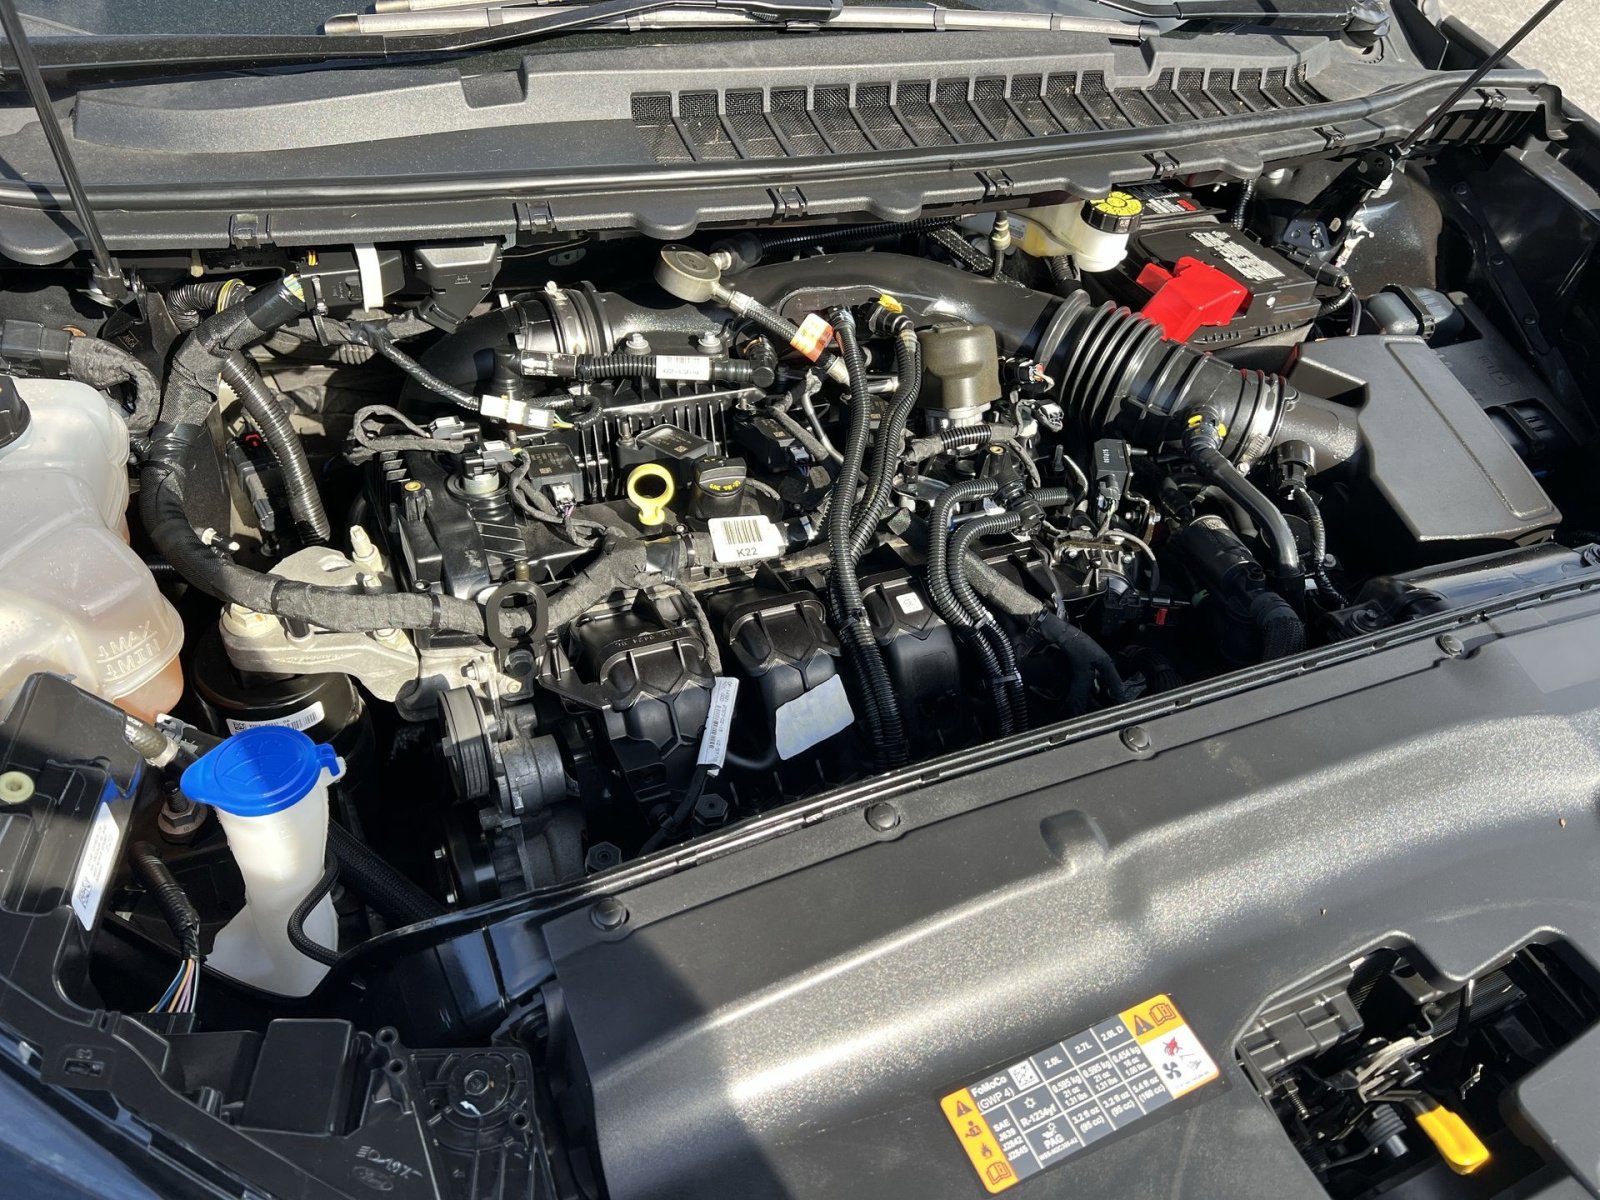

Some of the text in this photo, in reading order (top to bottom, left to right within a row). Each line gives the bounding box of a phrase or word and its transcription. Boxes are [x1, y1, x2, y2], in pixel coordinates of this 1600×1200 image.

[735, 547, 759, 559] K22
[1100, 1025, 1123, 1041] 2.0L D
[1074, 1042, 1092, 1053] 2.7L
[1129, 1046, 1140, 1054] kg
[1044, 1056, 1062, 1068] 2.0L
[1100, 1060, 1112, 1068] kg
[1069, 1075, 1081, 1083] kg
[971, 1076, 1006, 1096] FoMoCo
[977, 1087, 1014, 1110] (GWP 4)
[1020, 1103, 1055, 1126] R-1234yf
[993, 1119, 1010, 1131] SAE
[1044, 1134, 1063, 1148] PAG
